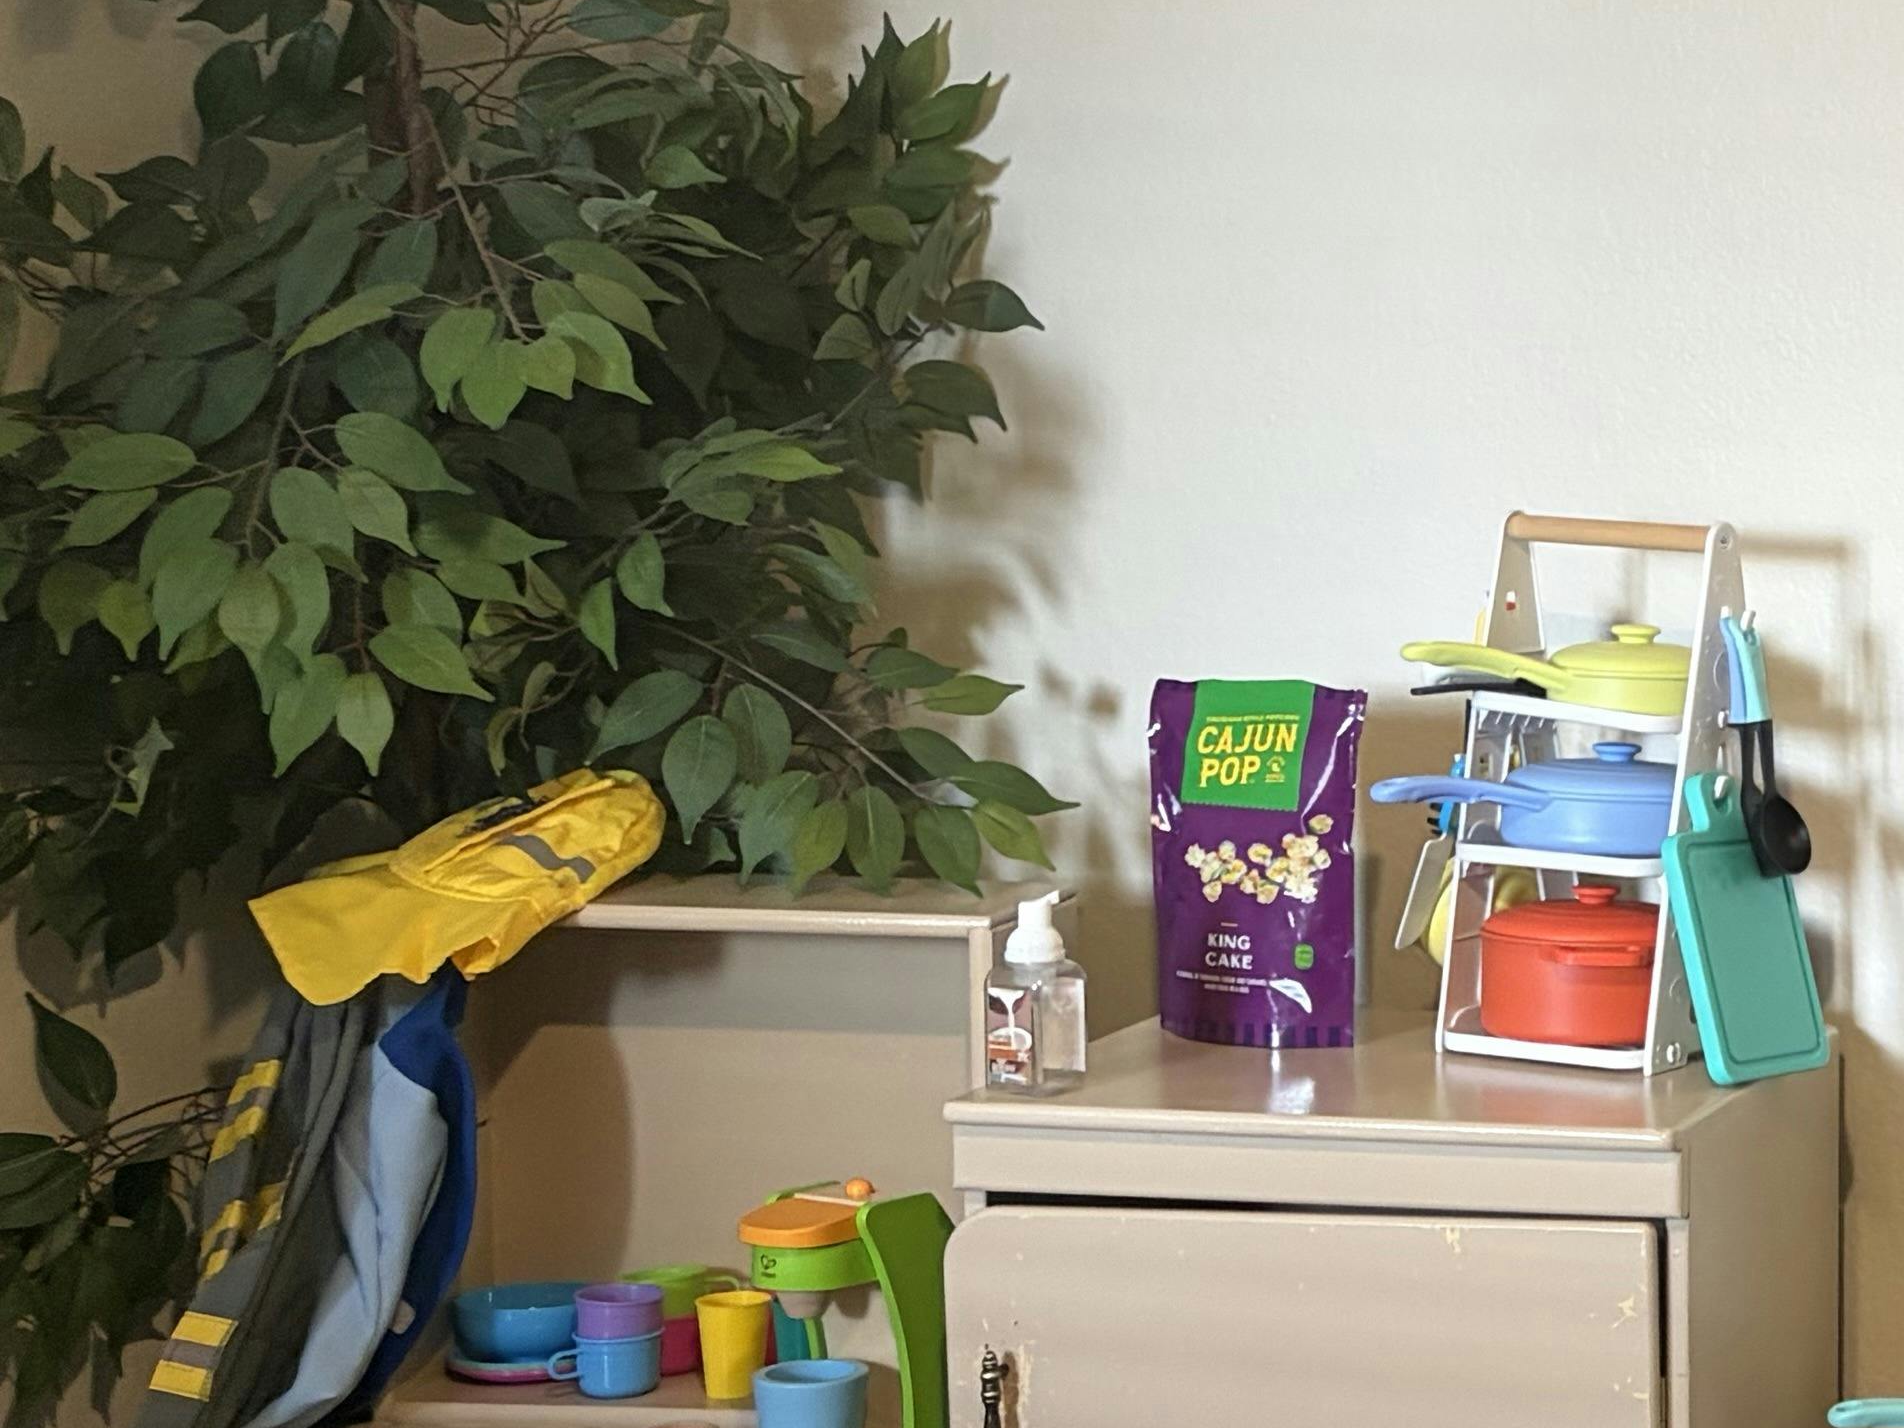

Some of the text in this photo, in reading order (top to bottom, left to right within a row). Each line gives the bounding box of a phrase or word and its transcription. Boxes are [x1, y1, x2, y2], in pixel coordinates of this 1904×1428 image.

[1197, 723, 1298, 754] CAJUN
[1199, 755, 1261, 788] POP
[1207, 933, 1251, 950] KING
[1205, 952, 1253, 970] CAKE
